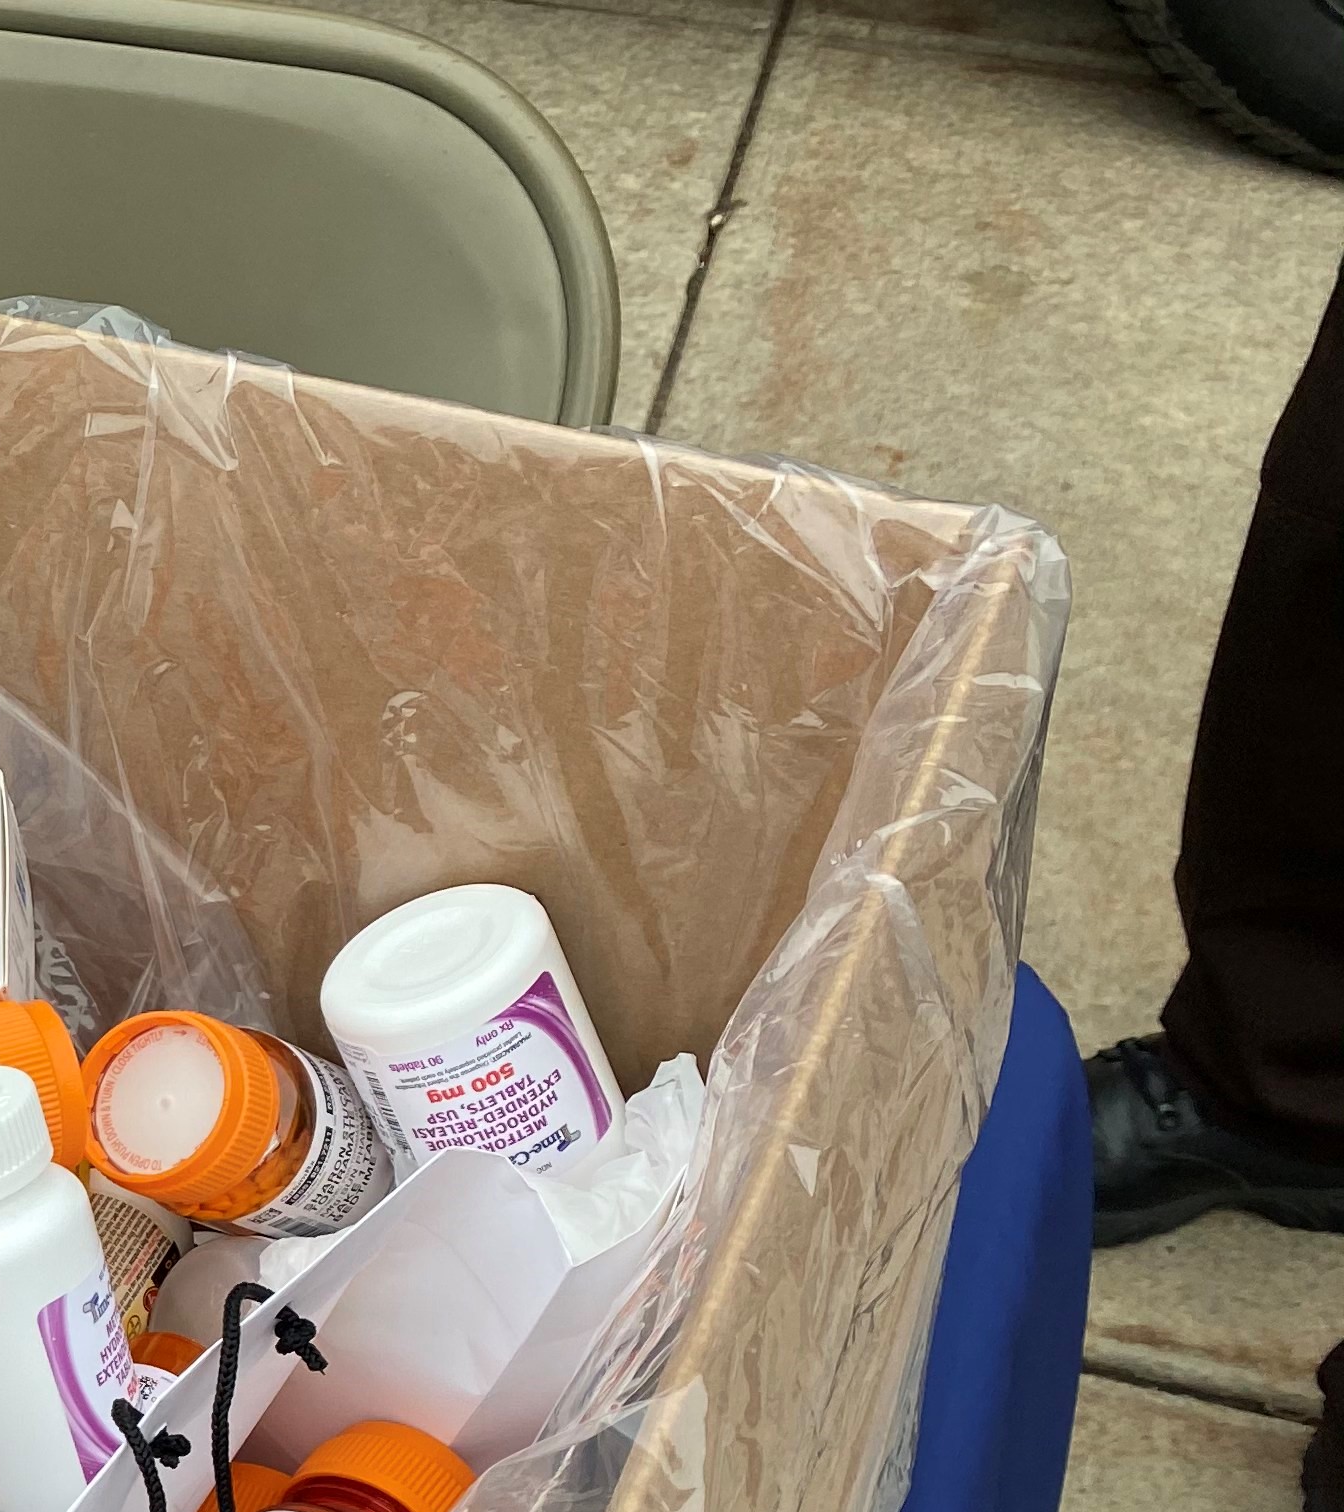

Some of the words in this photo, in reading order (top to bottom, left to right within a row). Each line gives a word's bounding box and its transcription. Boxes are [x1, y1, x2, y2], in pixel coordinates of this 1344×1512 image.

[498, 1018, 514, 1033] Rx
[475, 1029, 498, 1047] only
[388, 1059, 427, 1072] Tablets
[427, 1054, 444, 1067] 90
[470, 1062, 514, 1092] 500
[426, 1084, 464, 1103] mg
[460, 1074, 535, 1114] TABLETS,
[426, 1109, 458, 1131] USP
